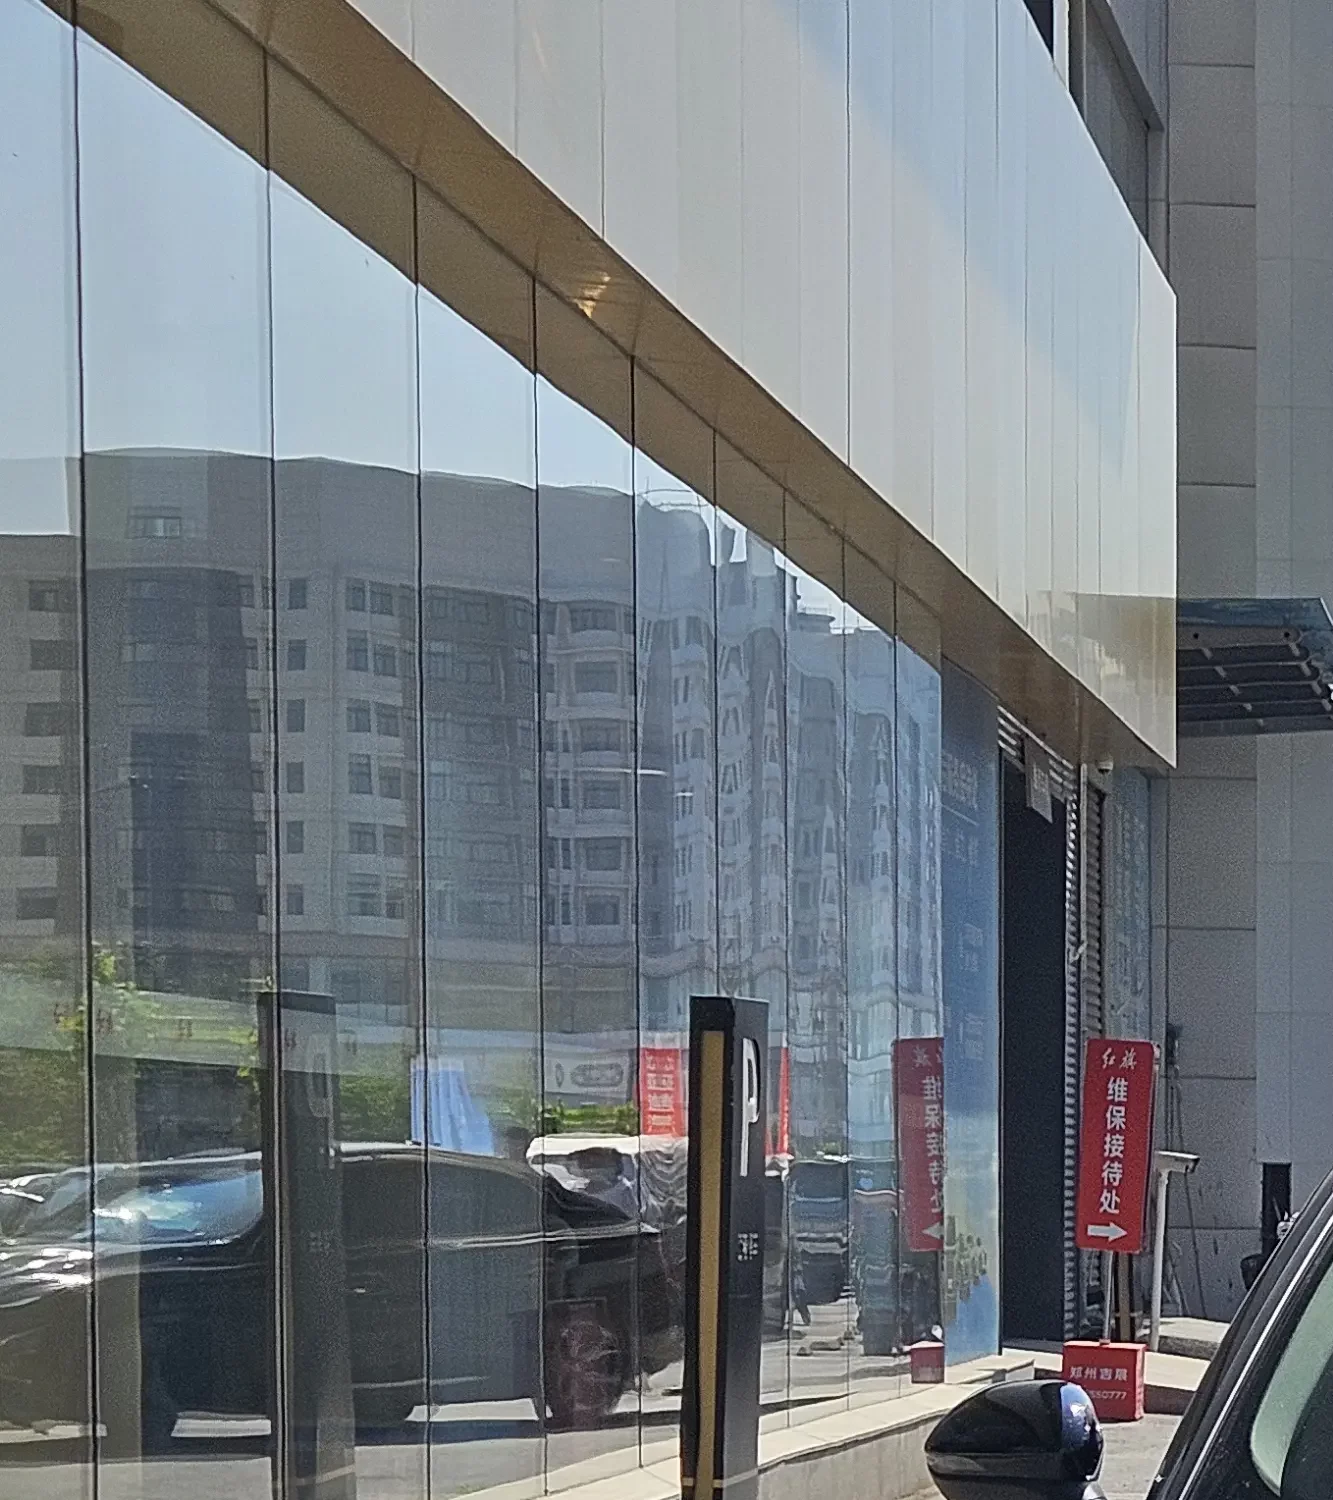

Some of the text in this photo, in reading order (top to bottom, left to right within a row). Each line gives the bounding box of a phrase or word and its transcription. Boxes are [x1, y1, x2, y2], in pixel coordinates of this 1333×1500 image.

[1102, 1047, 1138, 1070] 红旗
[1099, 1076, 1129, 1214] 维保接待处
